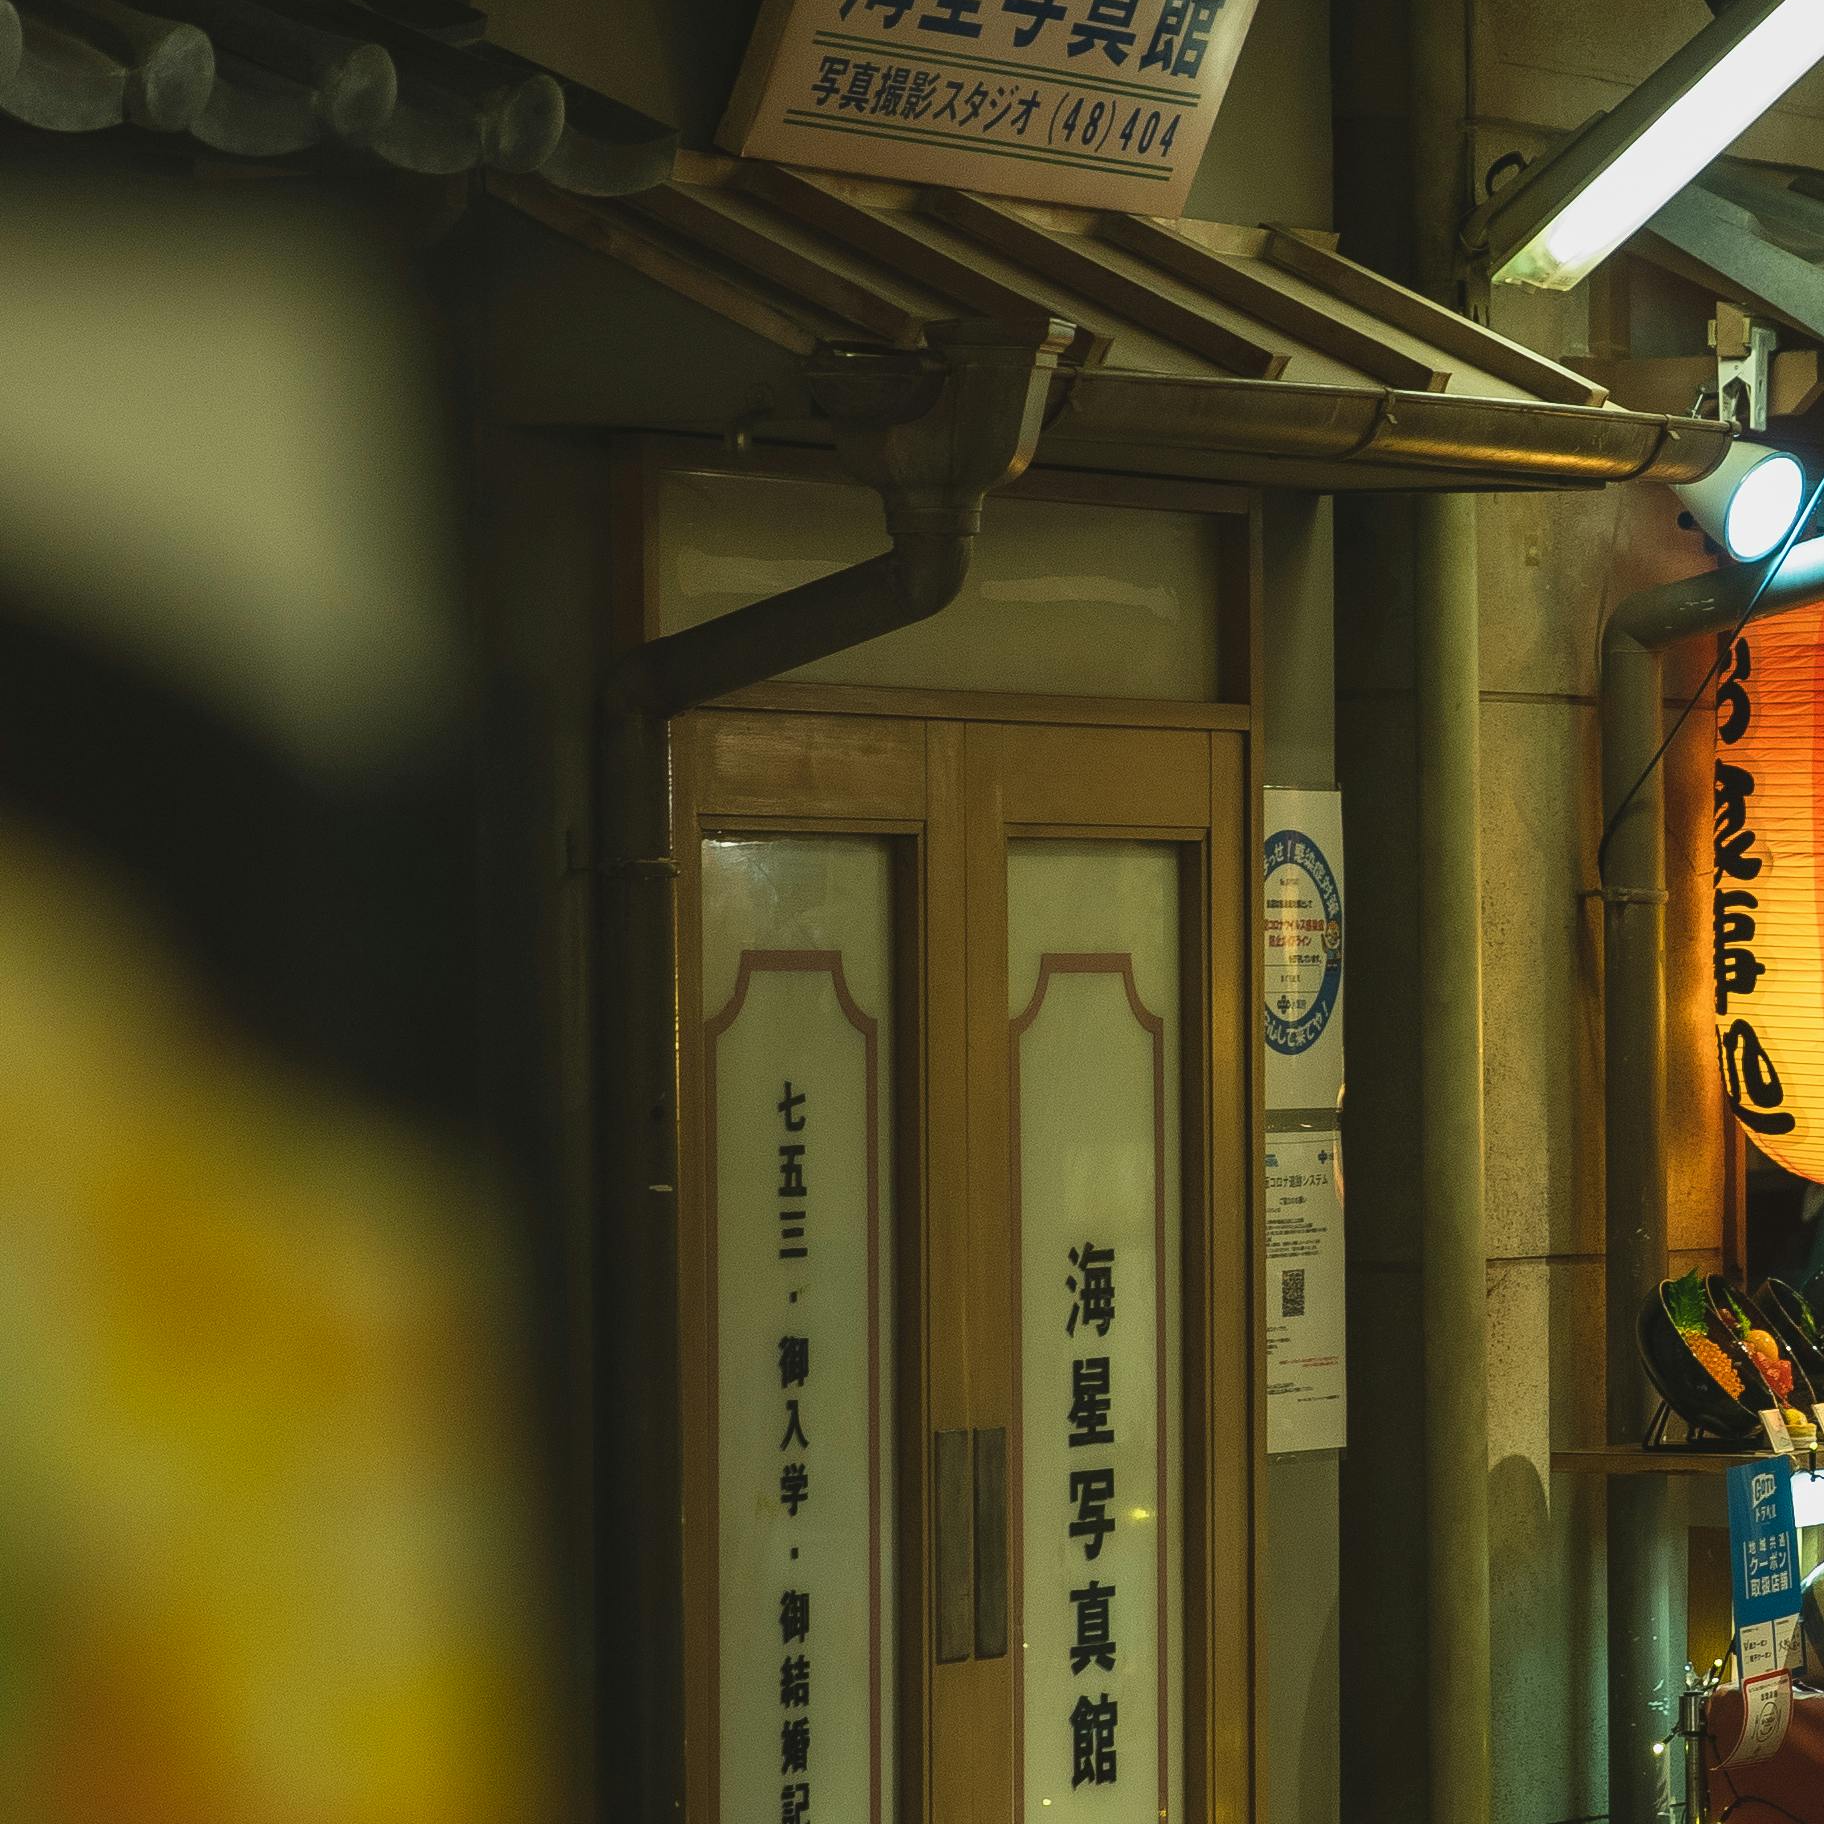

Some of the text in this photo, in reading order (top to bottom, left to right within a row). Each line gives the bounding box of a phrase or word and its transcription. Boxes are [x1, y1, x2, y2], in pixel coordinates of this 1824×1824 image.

[810, 56, 1182, 156] 写真撮影スタジオ (48)404
[1065, 1241, 1119, 1812] 海星写真館
